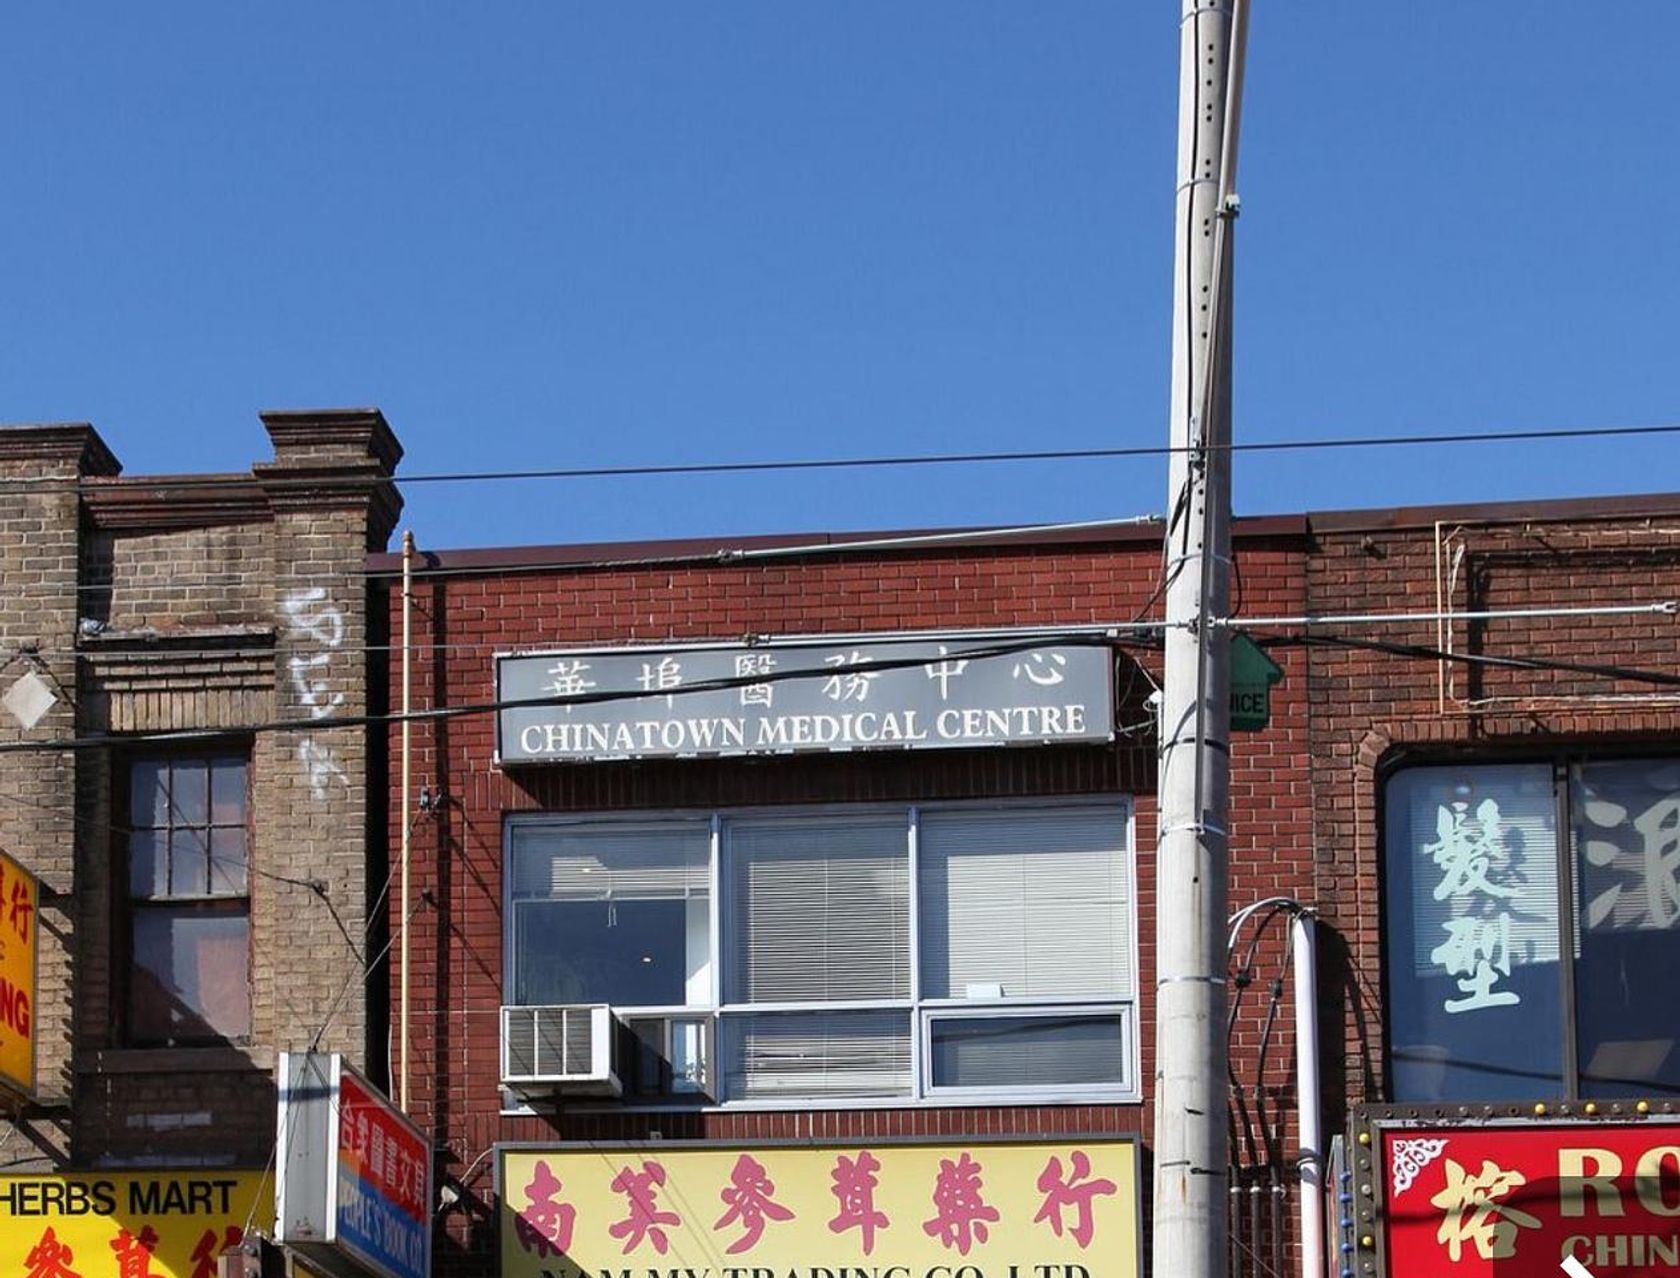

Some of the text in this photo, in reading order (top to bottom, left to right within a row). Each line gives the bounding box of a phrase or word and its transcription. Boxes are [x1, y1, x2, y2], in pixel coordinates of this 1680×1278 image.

[541, 644, 1067, 713] 華埠醫務中心
[520, 703, 1086, 755] CHINATOWN MEDICAL CENTRE
[129, 1180, 237, 1215] MART
